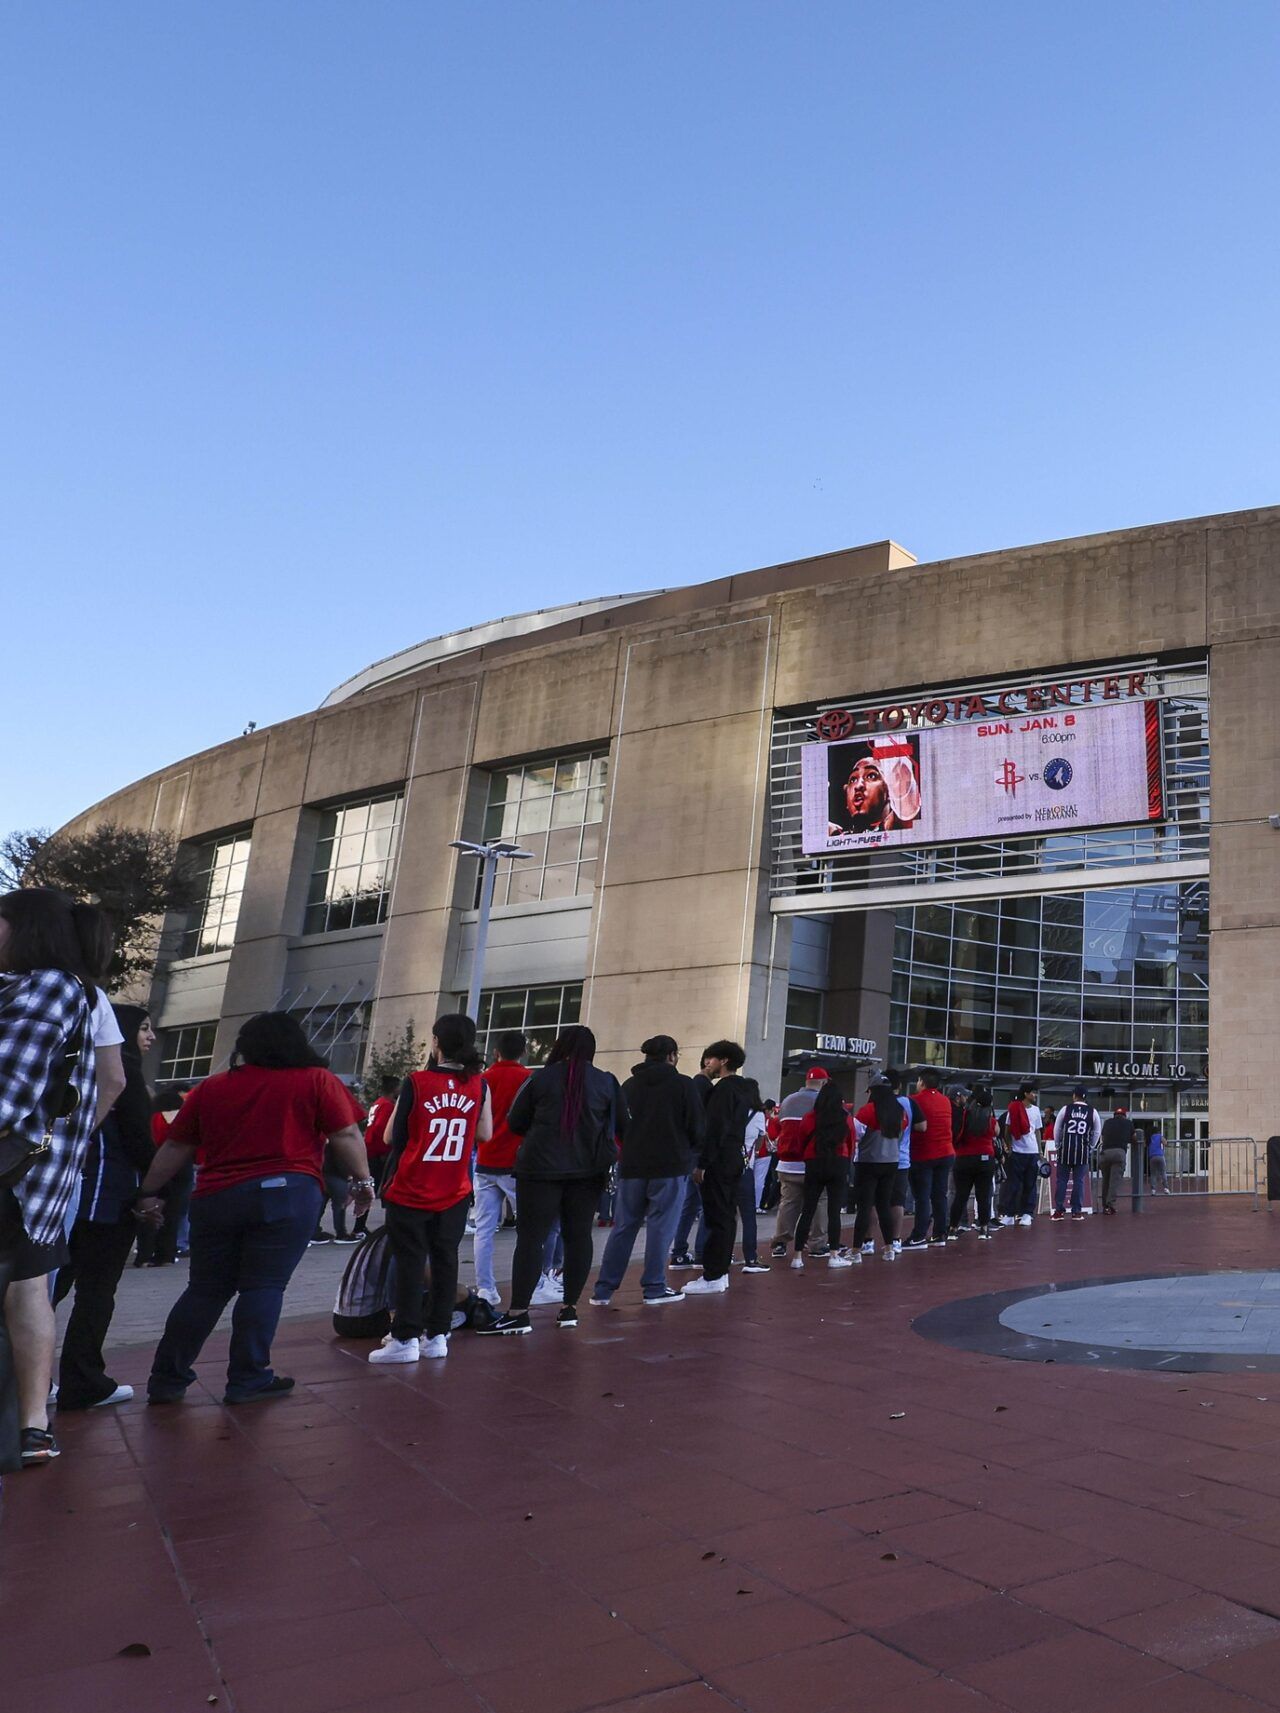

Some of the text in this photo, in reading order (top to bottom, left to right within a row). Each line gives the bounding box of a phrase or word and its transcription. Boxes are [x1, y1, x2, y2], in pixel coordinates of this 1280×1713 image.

[864, 672, 1147, 730] TOYOTA CENTER
[977, 714, 1076, 737] SUN. JAN. 8
[1041, 733, 1076, 744] 6:00pm
[1029, 773, 1042, 782] vs.
[997, 812, 1033, 823] presented by
[1034, 804, 1078, 816] MEMORIAL
[1034, 811, 1078, 822] HERMANN
[826, 838, 852, 847] LIGHT
[857, 835, 882, 844] FUSE
[816, 1033, 877, 1055] TEAM SHOP
[1094, 1062, 1186, 1077] WELCOME TO
[424, 1093, 475, 1114] SENGUN
[1067, 1119, 1087, 1135] 28
[422, 1118, 467, 1162] 28
